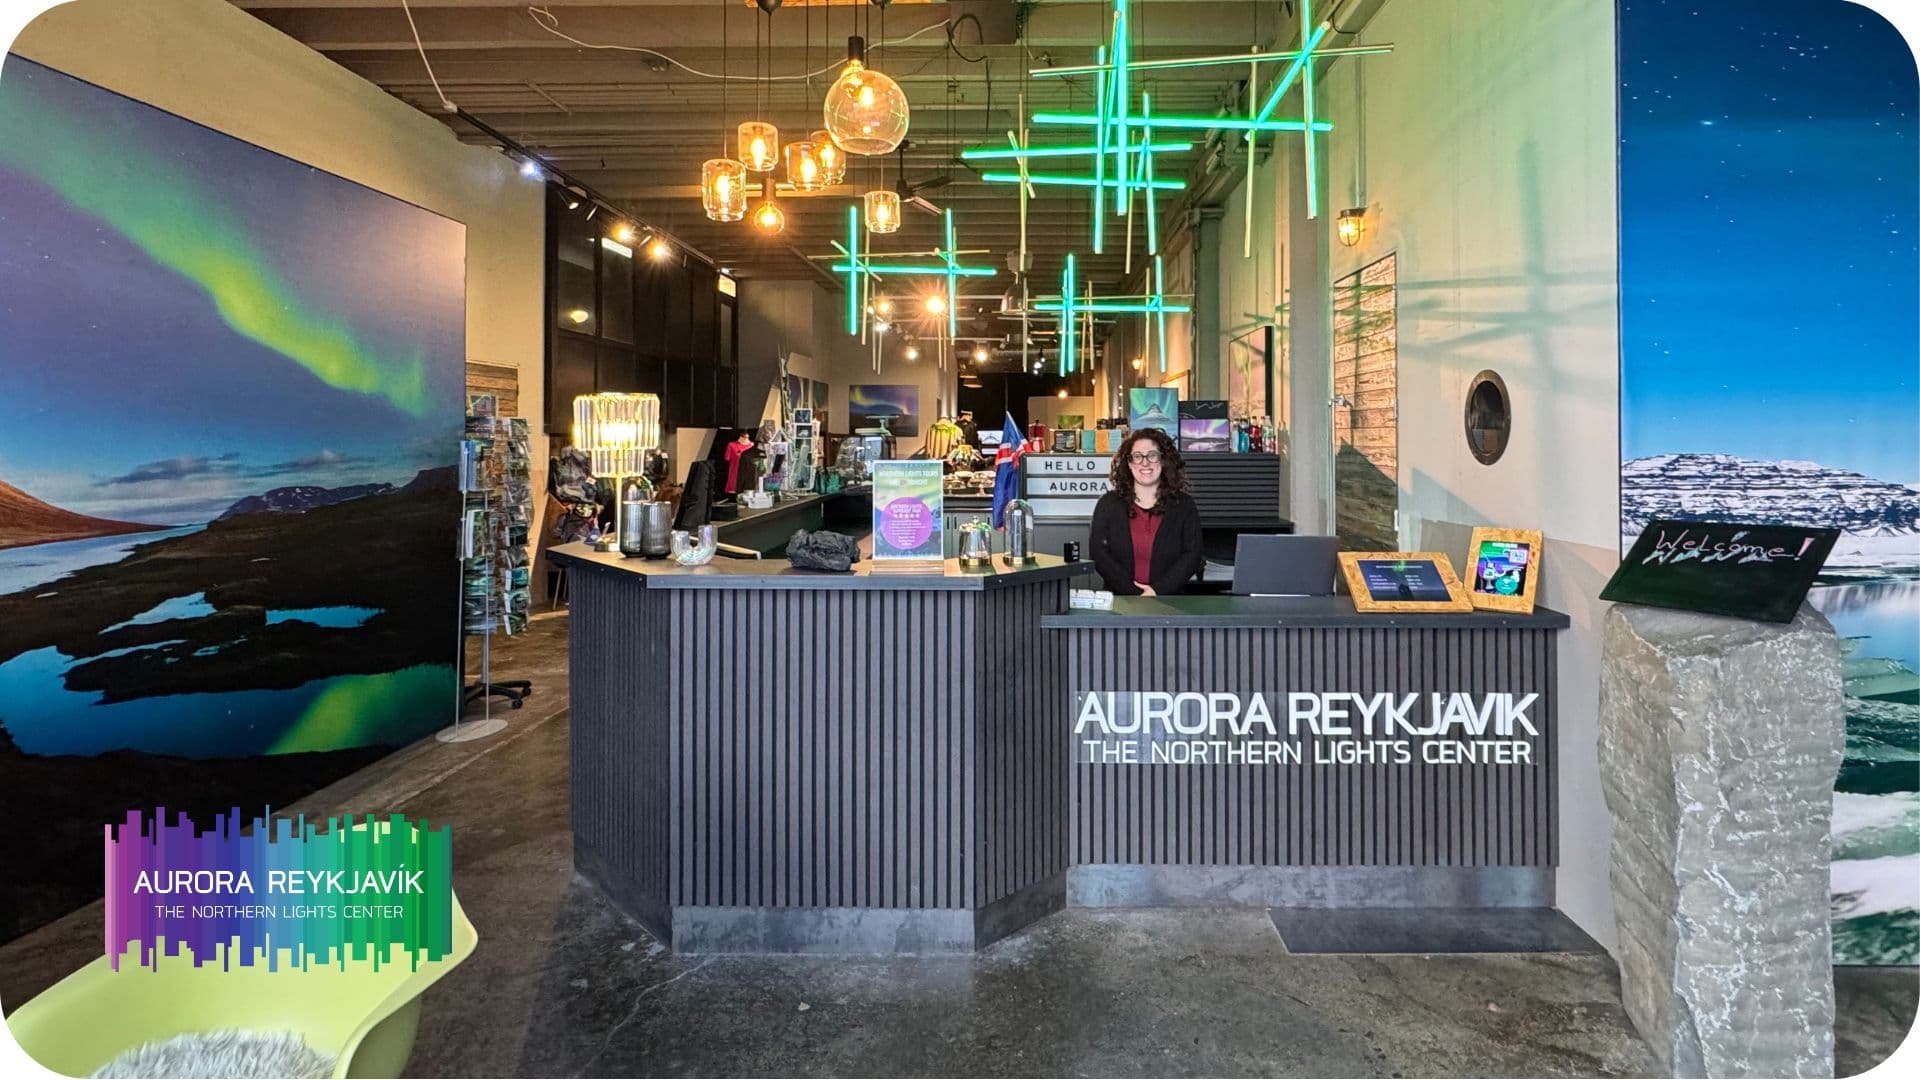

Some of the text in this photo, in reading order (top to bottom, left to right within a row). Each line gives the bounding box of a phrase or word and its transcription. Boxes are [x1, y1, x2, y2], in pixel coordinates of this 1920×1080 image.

[1045, 461, 1096, 471] HELLO
[1049, 482, 1108, 492] AURORA
[1074, 692, 1539, 736] AURORA REYKJAVIK
[1083, 740, 1531, 765] THE NORTHERN LIGHTS CENTER
